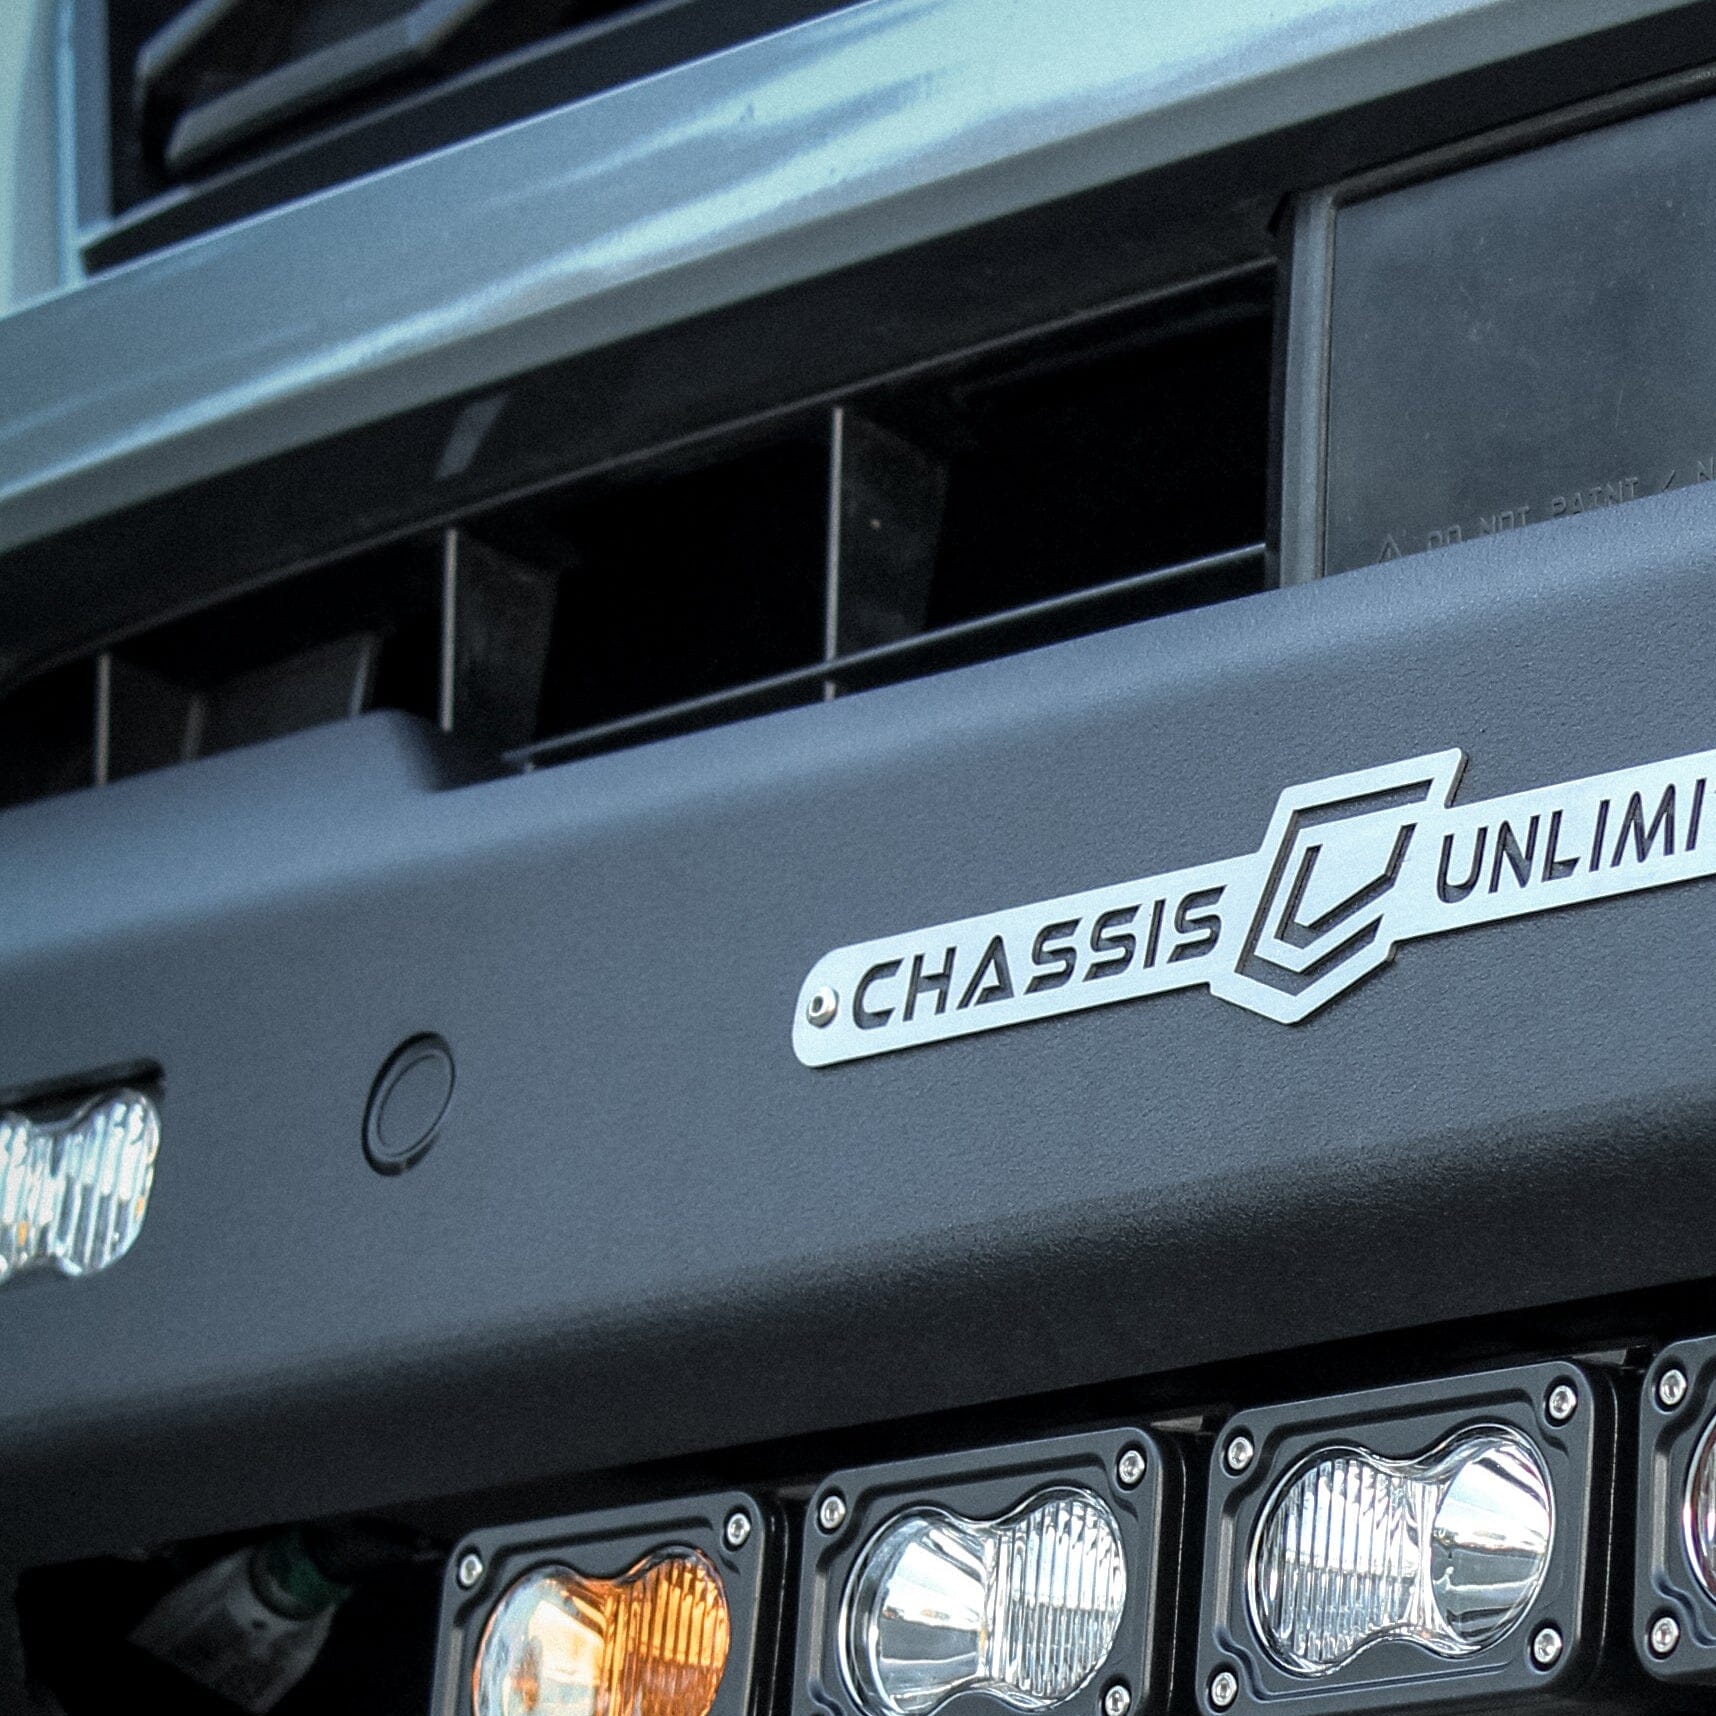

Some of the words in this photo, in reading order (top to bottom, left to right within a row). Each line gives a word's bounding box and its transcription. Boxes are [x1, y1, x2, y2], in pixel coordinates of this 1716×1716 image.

[1480, 505, 1530, 537] NOT
[1551, 476, 1638, 516] PAINT
[851, 884, 1228, 1030] CHASSIS
